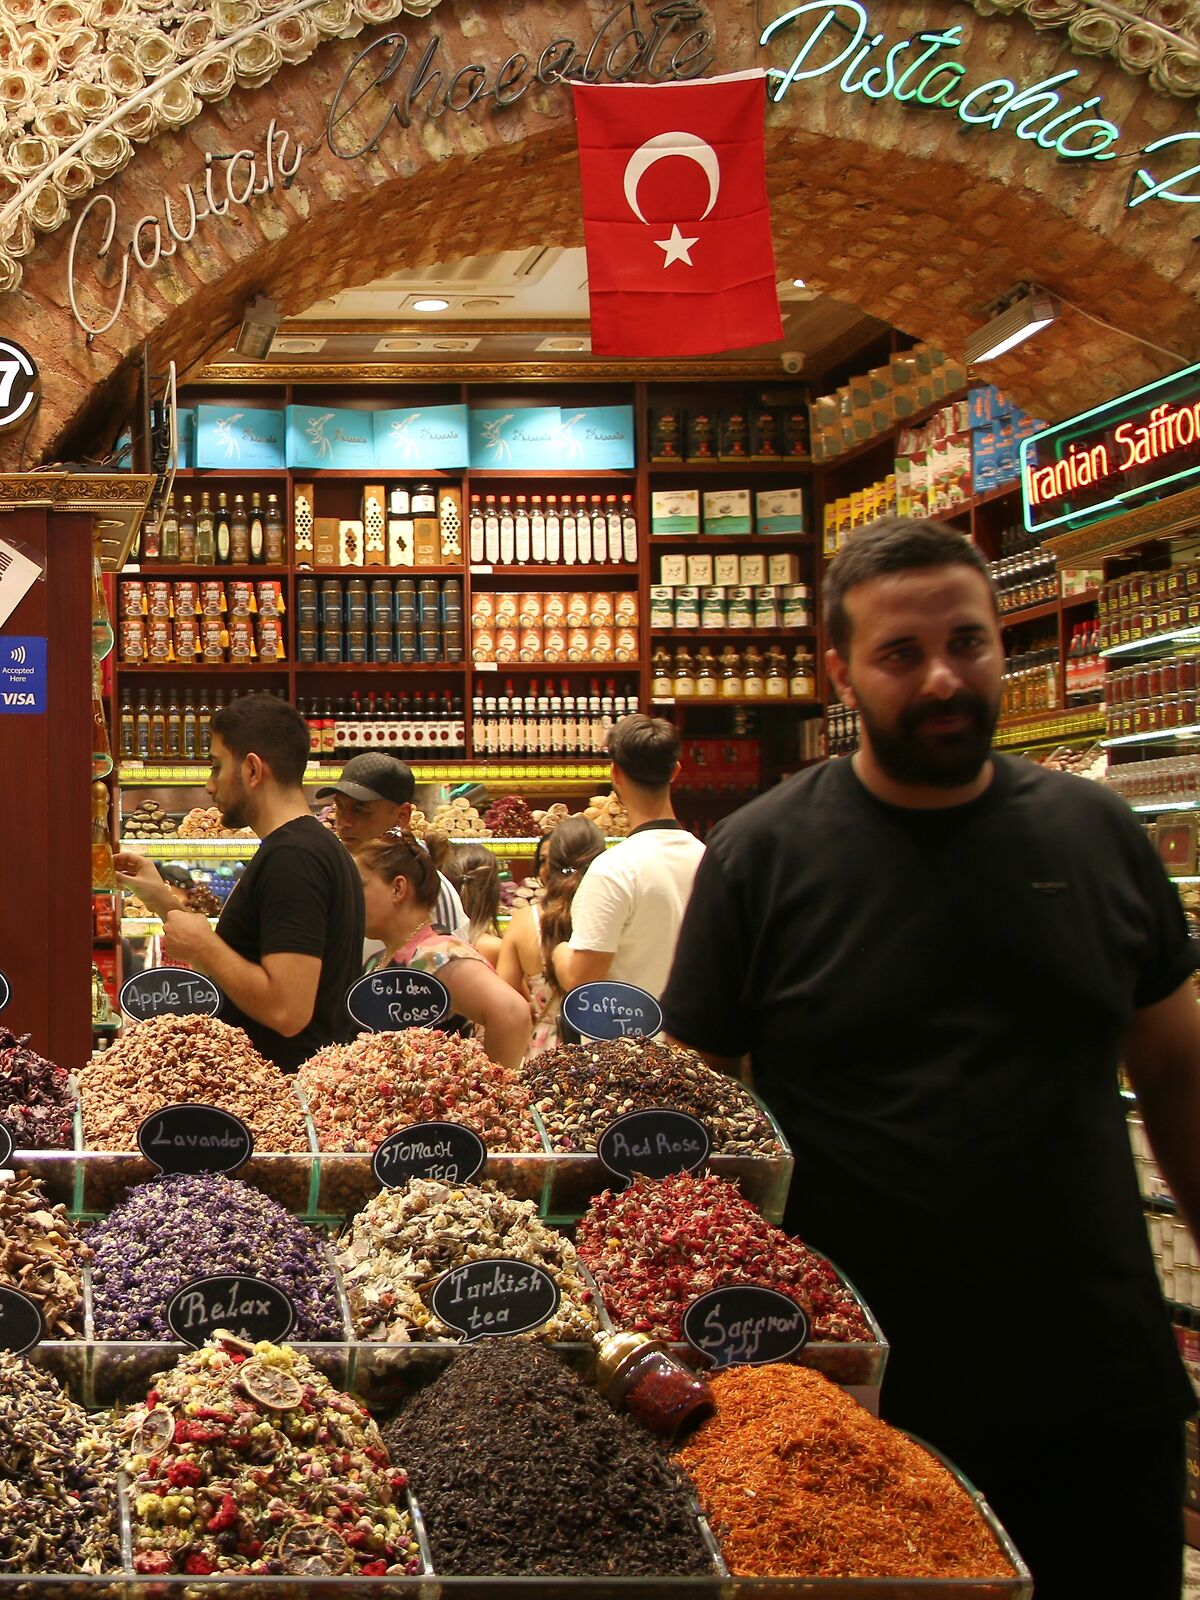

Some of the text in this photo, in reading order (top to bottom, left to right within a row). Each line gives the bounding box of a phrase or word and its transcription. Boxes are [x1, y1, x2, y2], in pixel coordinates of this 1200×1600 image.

[760, 0, 1119, 159] Pistachio
[1026, 444, 1109, 505] Iranian
[2, 667, 35, 676] Accepted
[9, 674, 27, 683] Here
[1, 693, 35, 705] VISA
[127, 981, 217, 1012] Apple Tea
[578, 991, 643, 1017] Saffron
[388, 1002, 440, 1023] Roses
[613, 1018, 643, 1035] Tea
[151, 1121, 244, 1148] Lavander
[612, 1133, 700, 1158] Red Rose
[424, 1164, 458, 1183] TEA
[450, 1266, 542, 1305] Turkish
[181, 1281, 271, 1328] Relax
[468, 1308, 510, 1329] tea
